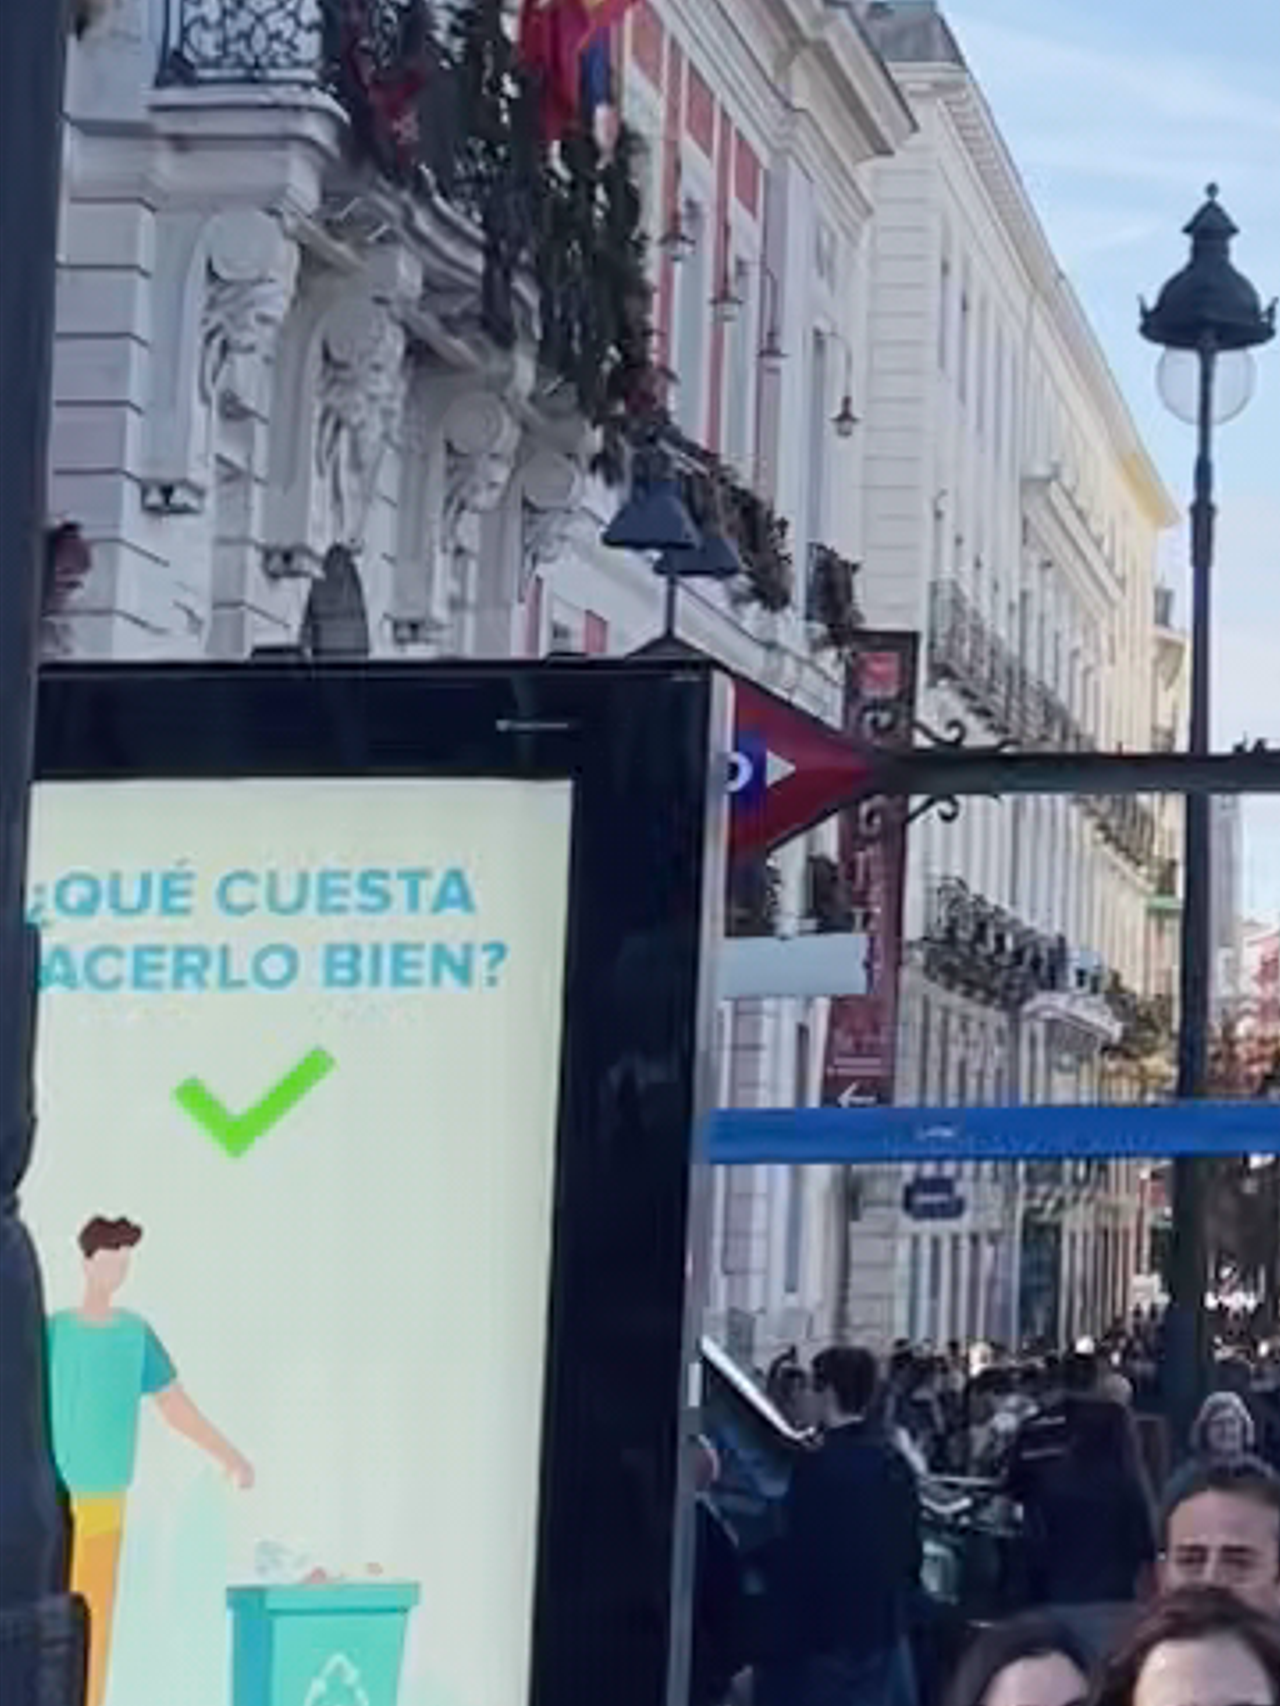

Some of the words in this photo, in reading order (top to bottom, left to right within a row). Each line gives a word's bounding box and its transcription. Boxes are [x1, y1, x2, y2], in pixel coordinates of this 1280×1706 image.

[27, 858, 197, 928] ¿QUÉ
[216, 870, 477, 917] CUESTA
[324, 941, 510, 989] BIEN?
